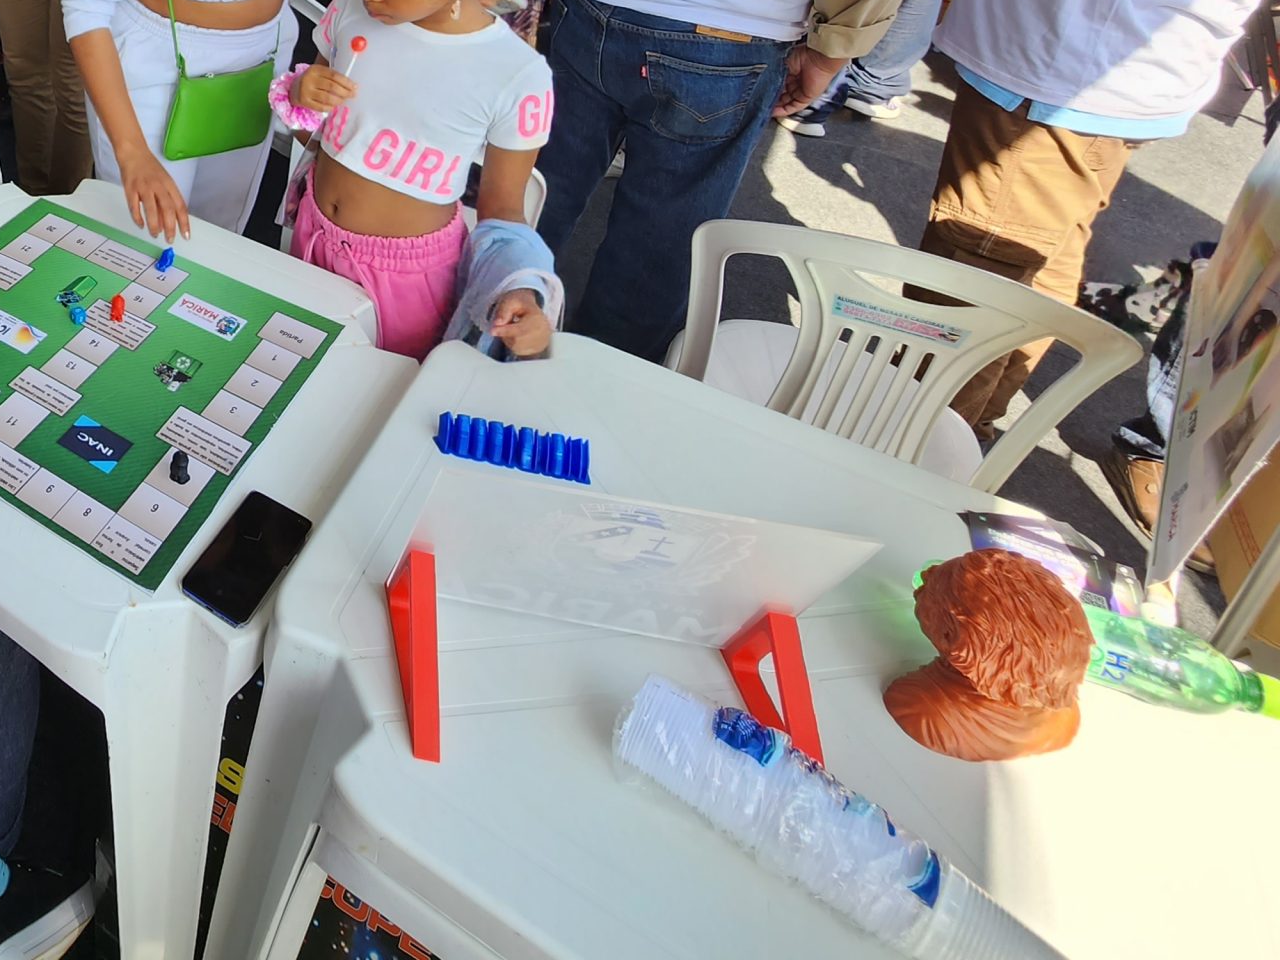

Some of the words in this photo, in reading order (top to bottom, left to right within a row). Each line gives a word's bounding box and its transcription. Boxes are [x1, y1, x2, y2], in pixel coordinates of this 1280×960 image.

[363, 128, 463, 196] GIRL
[133, 295, 143, 303] 16
[279, 330, 303, 343] Partida
[89, 339, 100, 347] 14
[65, 361, 76, 370] 13
[229, 406, 237, 414] 3
[6, 416, 18, 426] 11
[77, 432, 113, 456] INAC
[46, 485, 55, 493] 9
[83, 508, 92, 517] 8
[150, 504, 159, 512] 6
